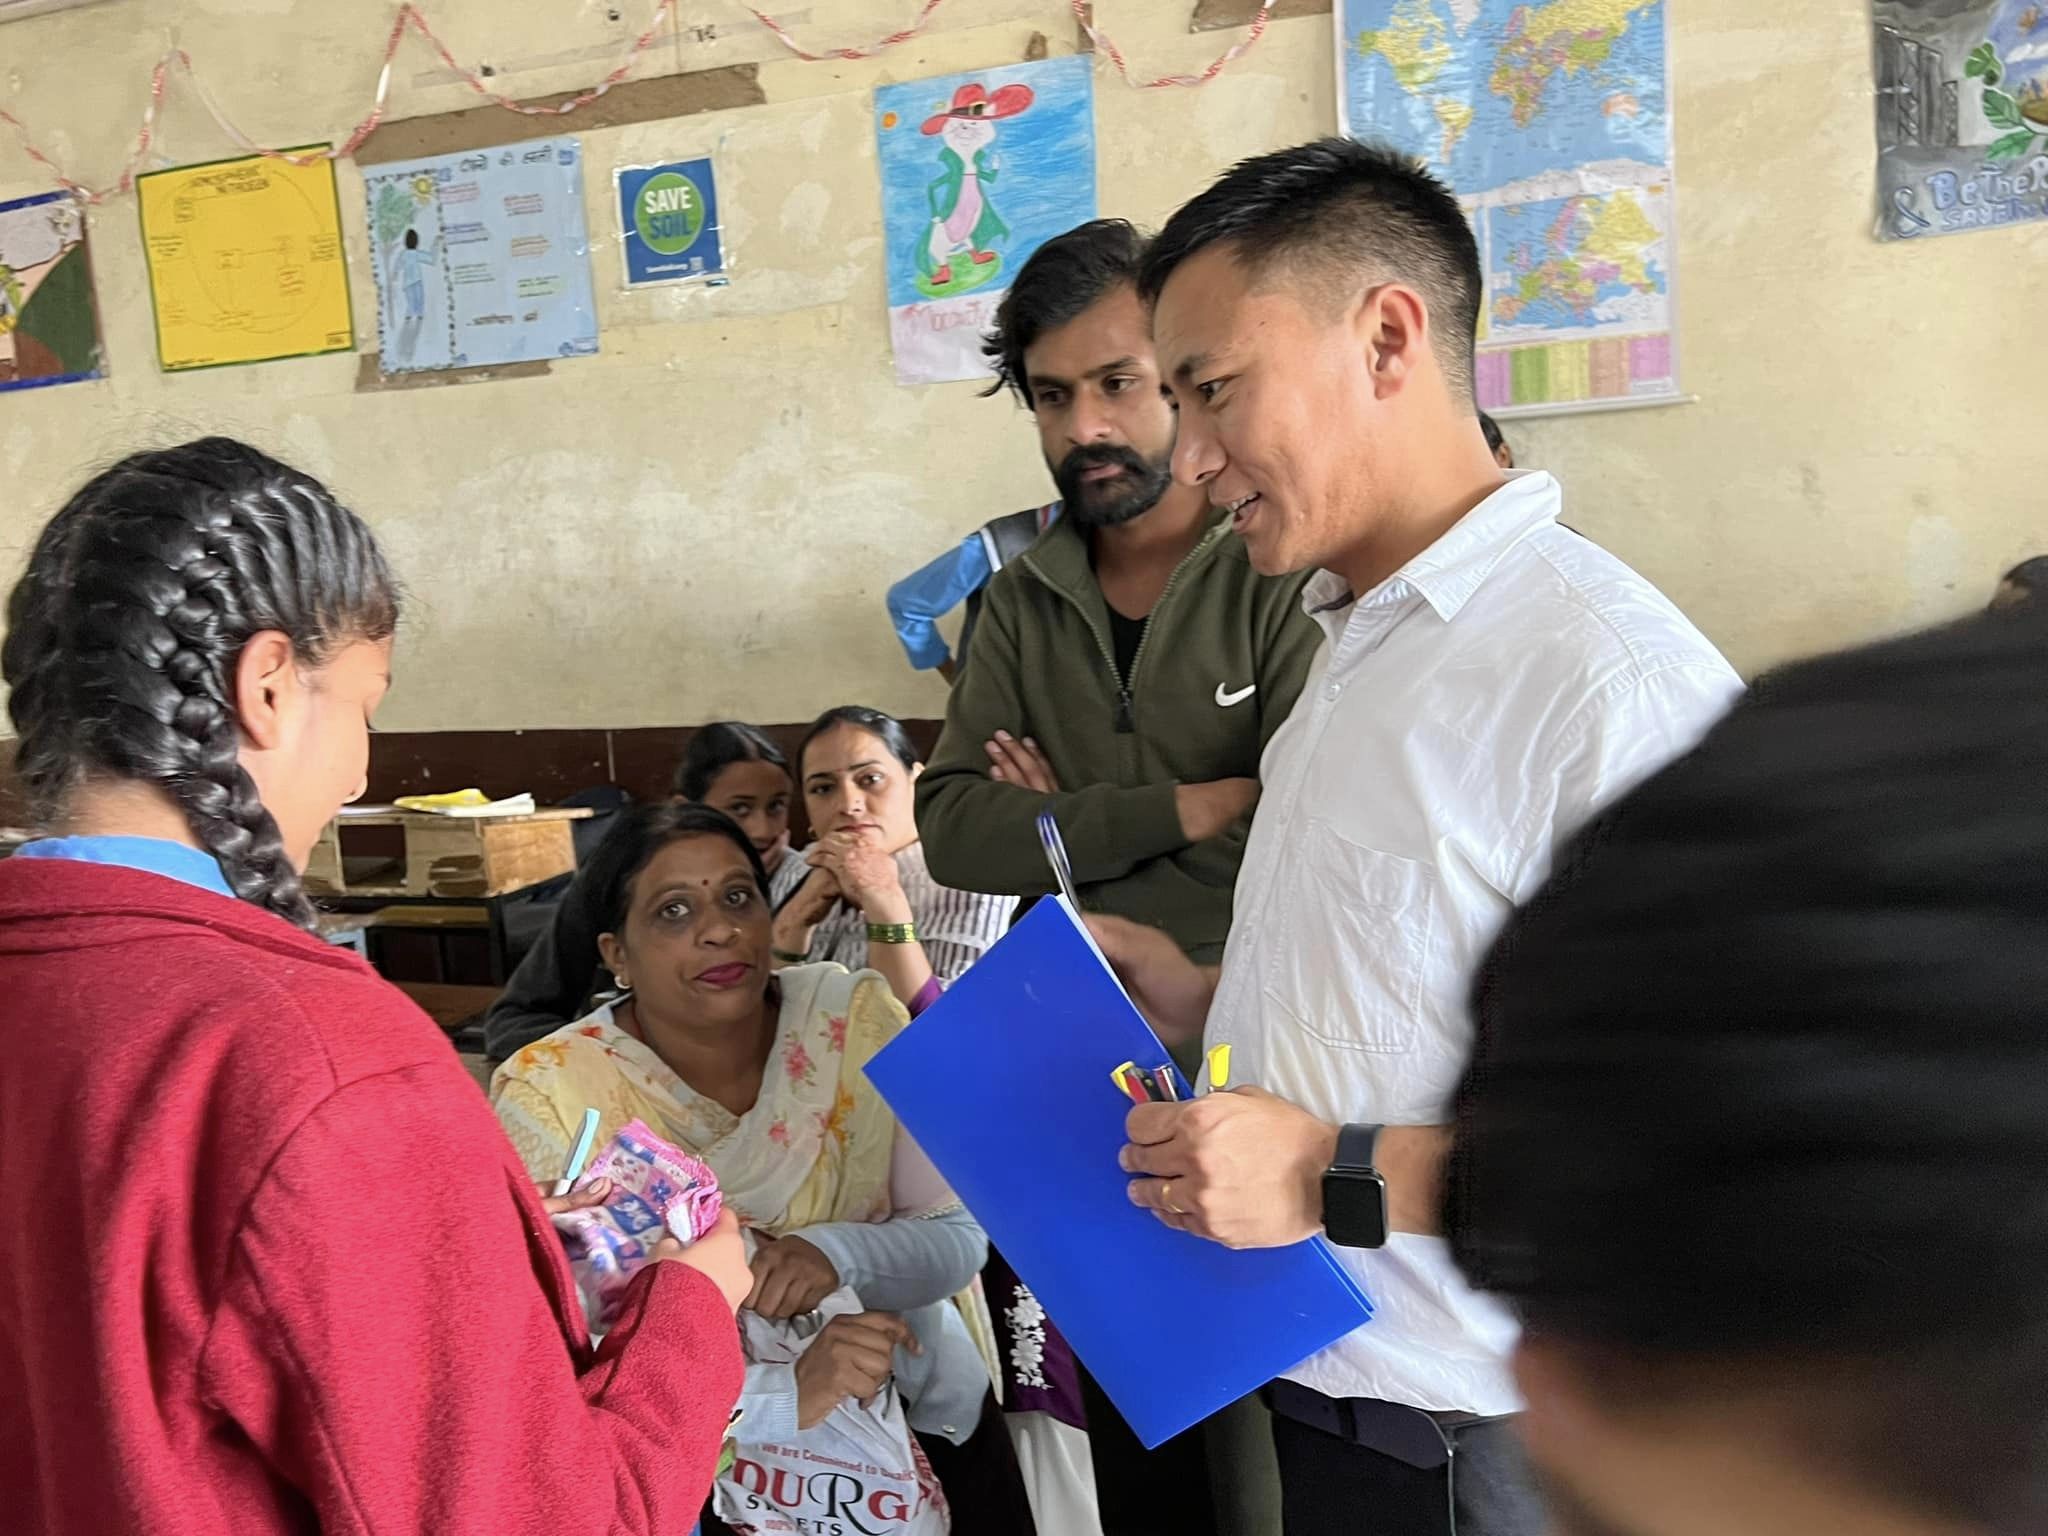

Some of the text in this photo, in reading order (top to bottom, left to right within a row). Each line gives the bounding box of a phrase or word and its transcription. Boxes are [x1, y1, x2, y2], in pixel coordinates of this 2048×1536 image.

[644, 186, 693, 214] SAVE
[649, 212, 693, 240] SOIL
[746, 1493, 843, 1536] SETS
